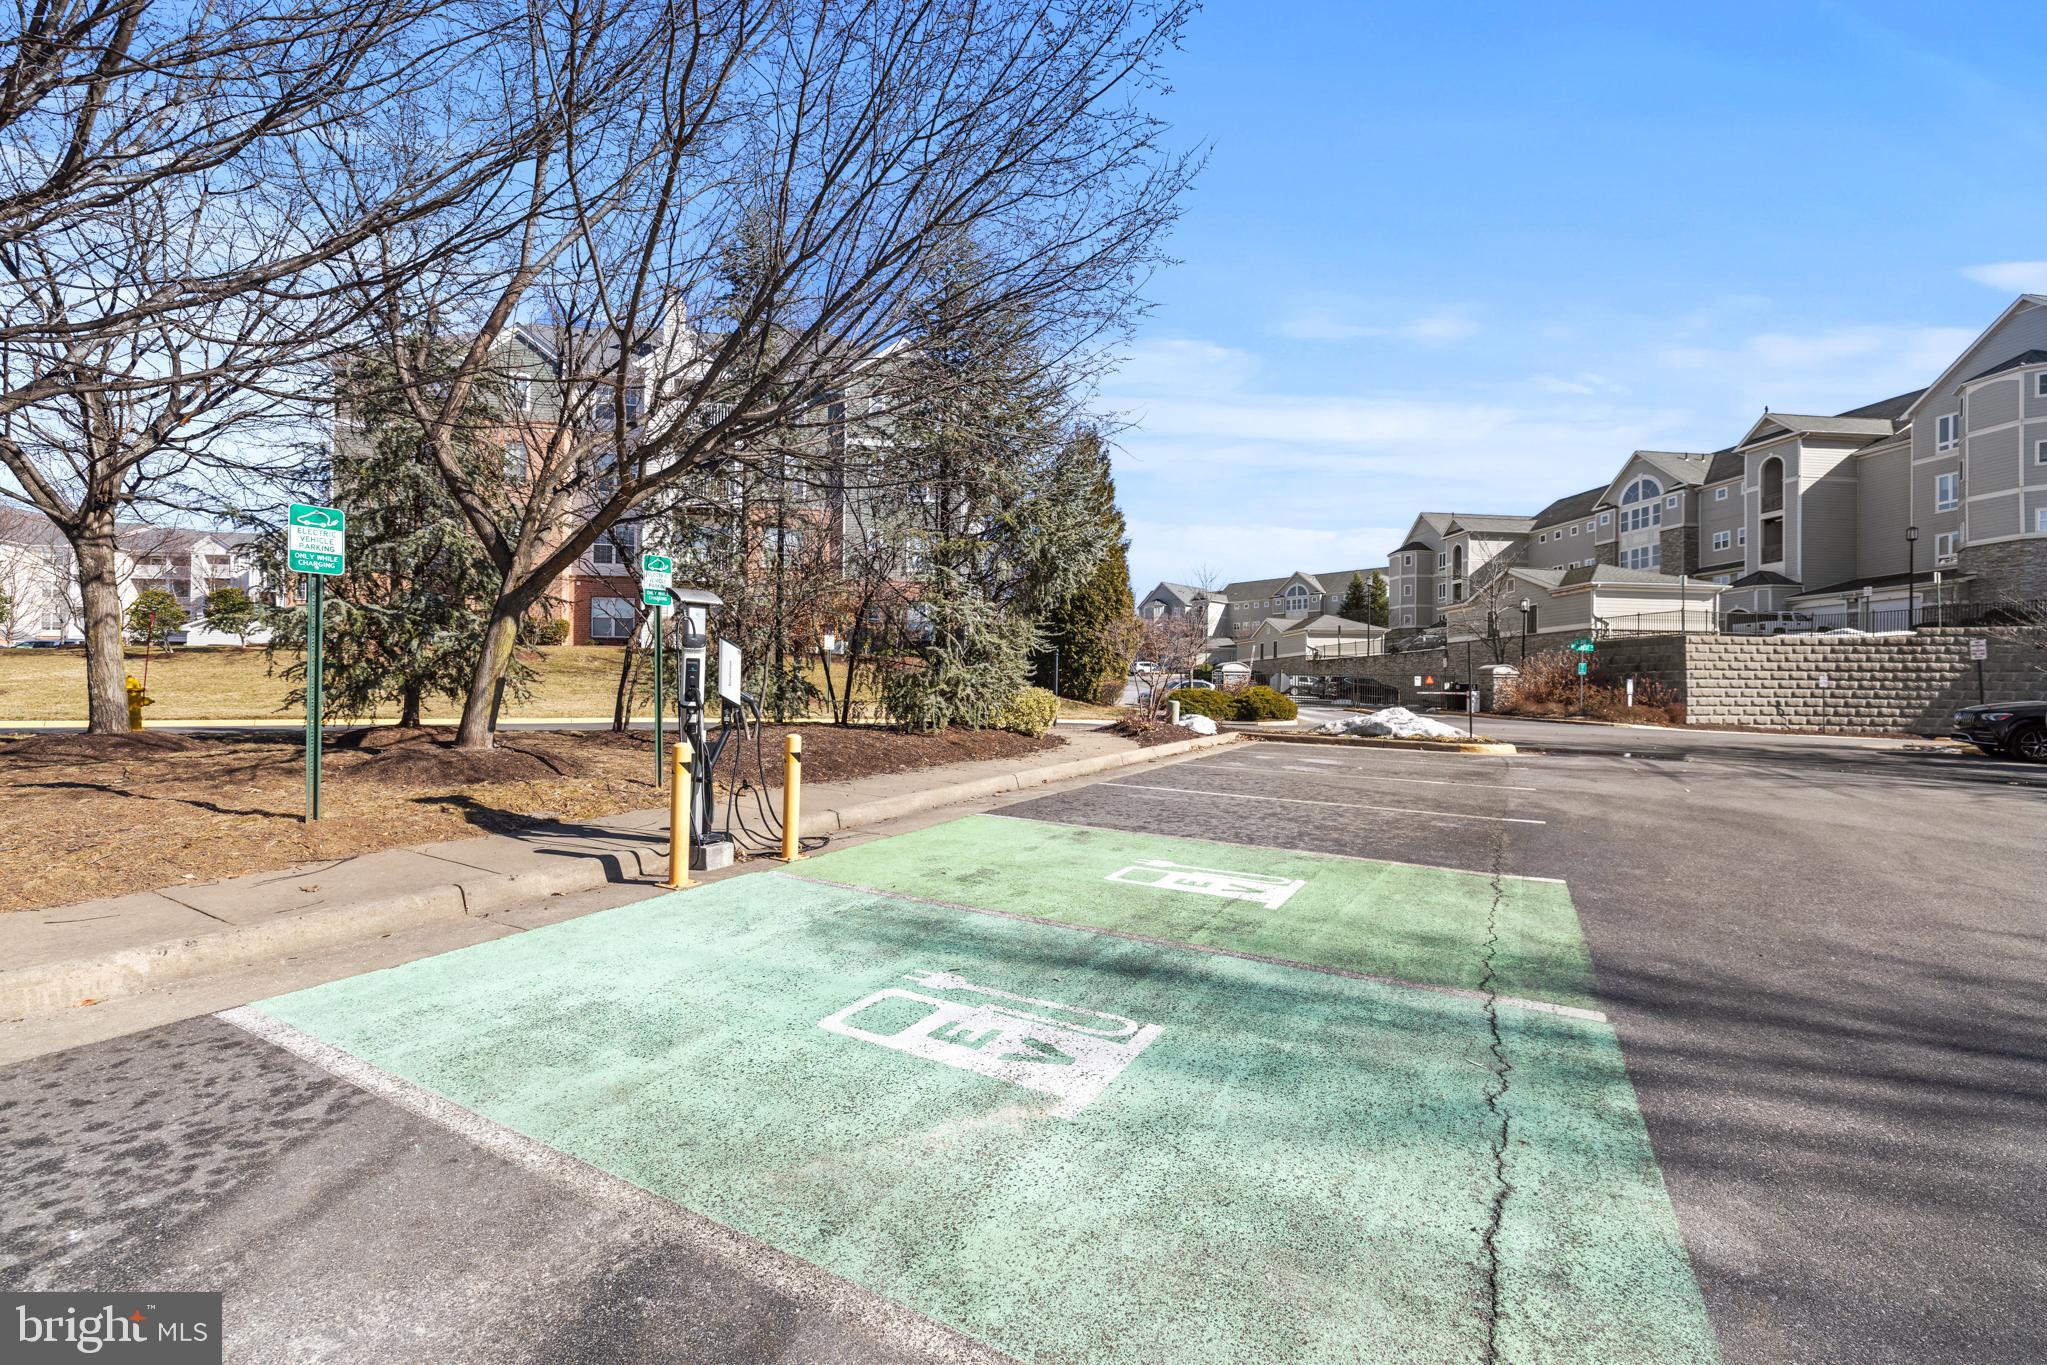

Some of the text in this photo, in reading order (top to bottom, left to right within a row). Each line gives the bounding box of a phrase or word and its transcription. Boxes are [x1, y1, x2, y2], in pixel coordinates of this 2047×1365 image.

[297, 527, 337, 538] ELECTRIC
[300, 536, 334, 546] VEHICLE
[299, 543, 335, 553] PARKING
[294, 552, 339, 563] ONLY WHILE
[298, 560, 336, 569] CHARGING
